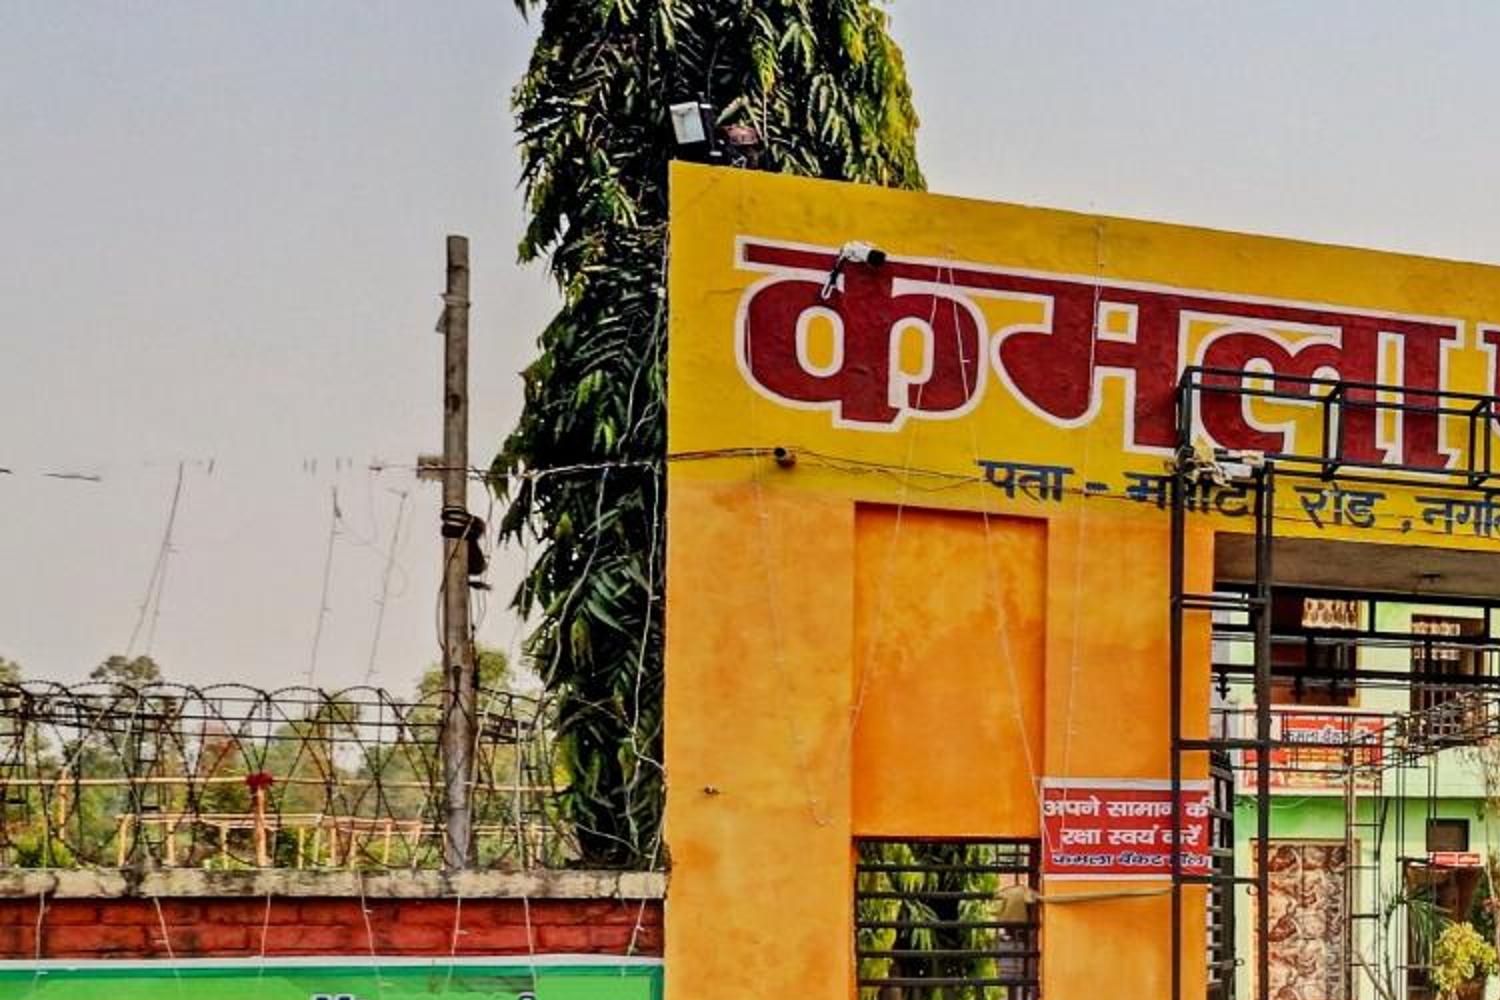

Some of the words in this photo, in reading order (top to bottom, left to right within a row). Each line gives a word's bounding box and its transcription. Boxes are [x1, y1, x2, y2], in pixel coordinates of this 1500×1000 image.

[738, 237, 1464, 472] कमला
[979, 460, 1073, 503] पता
[1044, 795, 1101, 817] अपने
[1060, 827, 1101, 846] रक्षा
[1106, 824, 1157, 846] स्वयं
